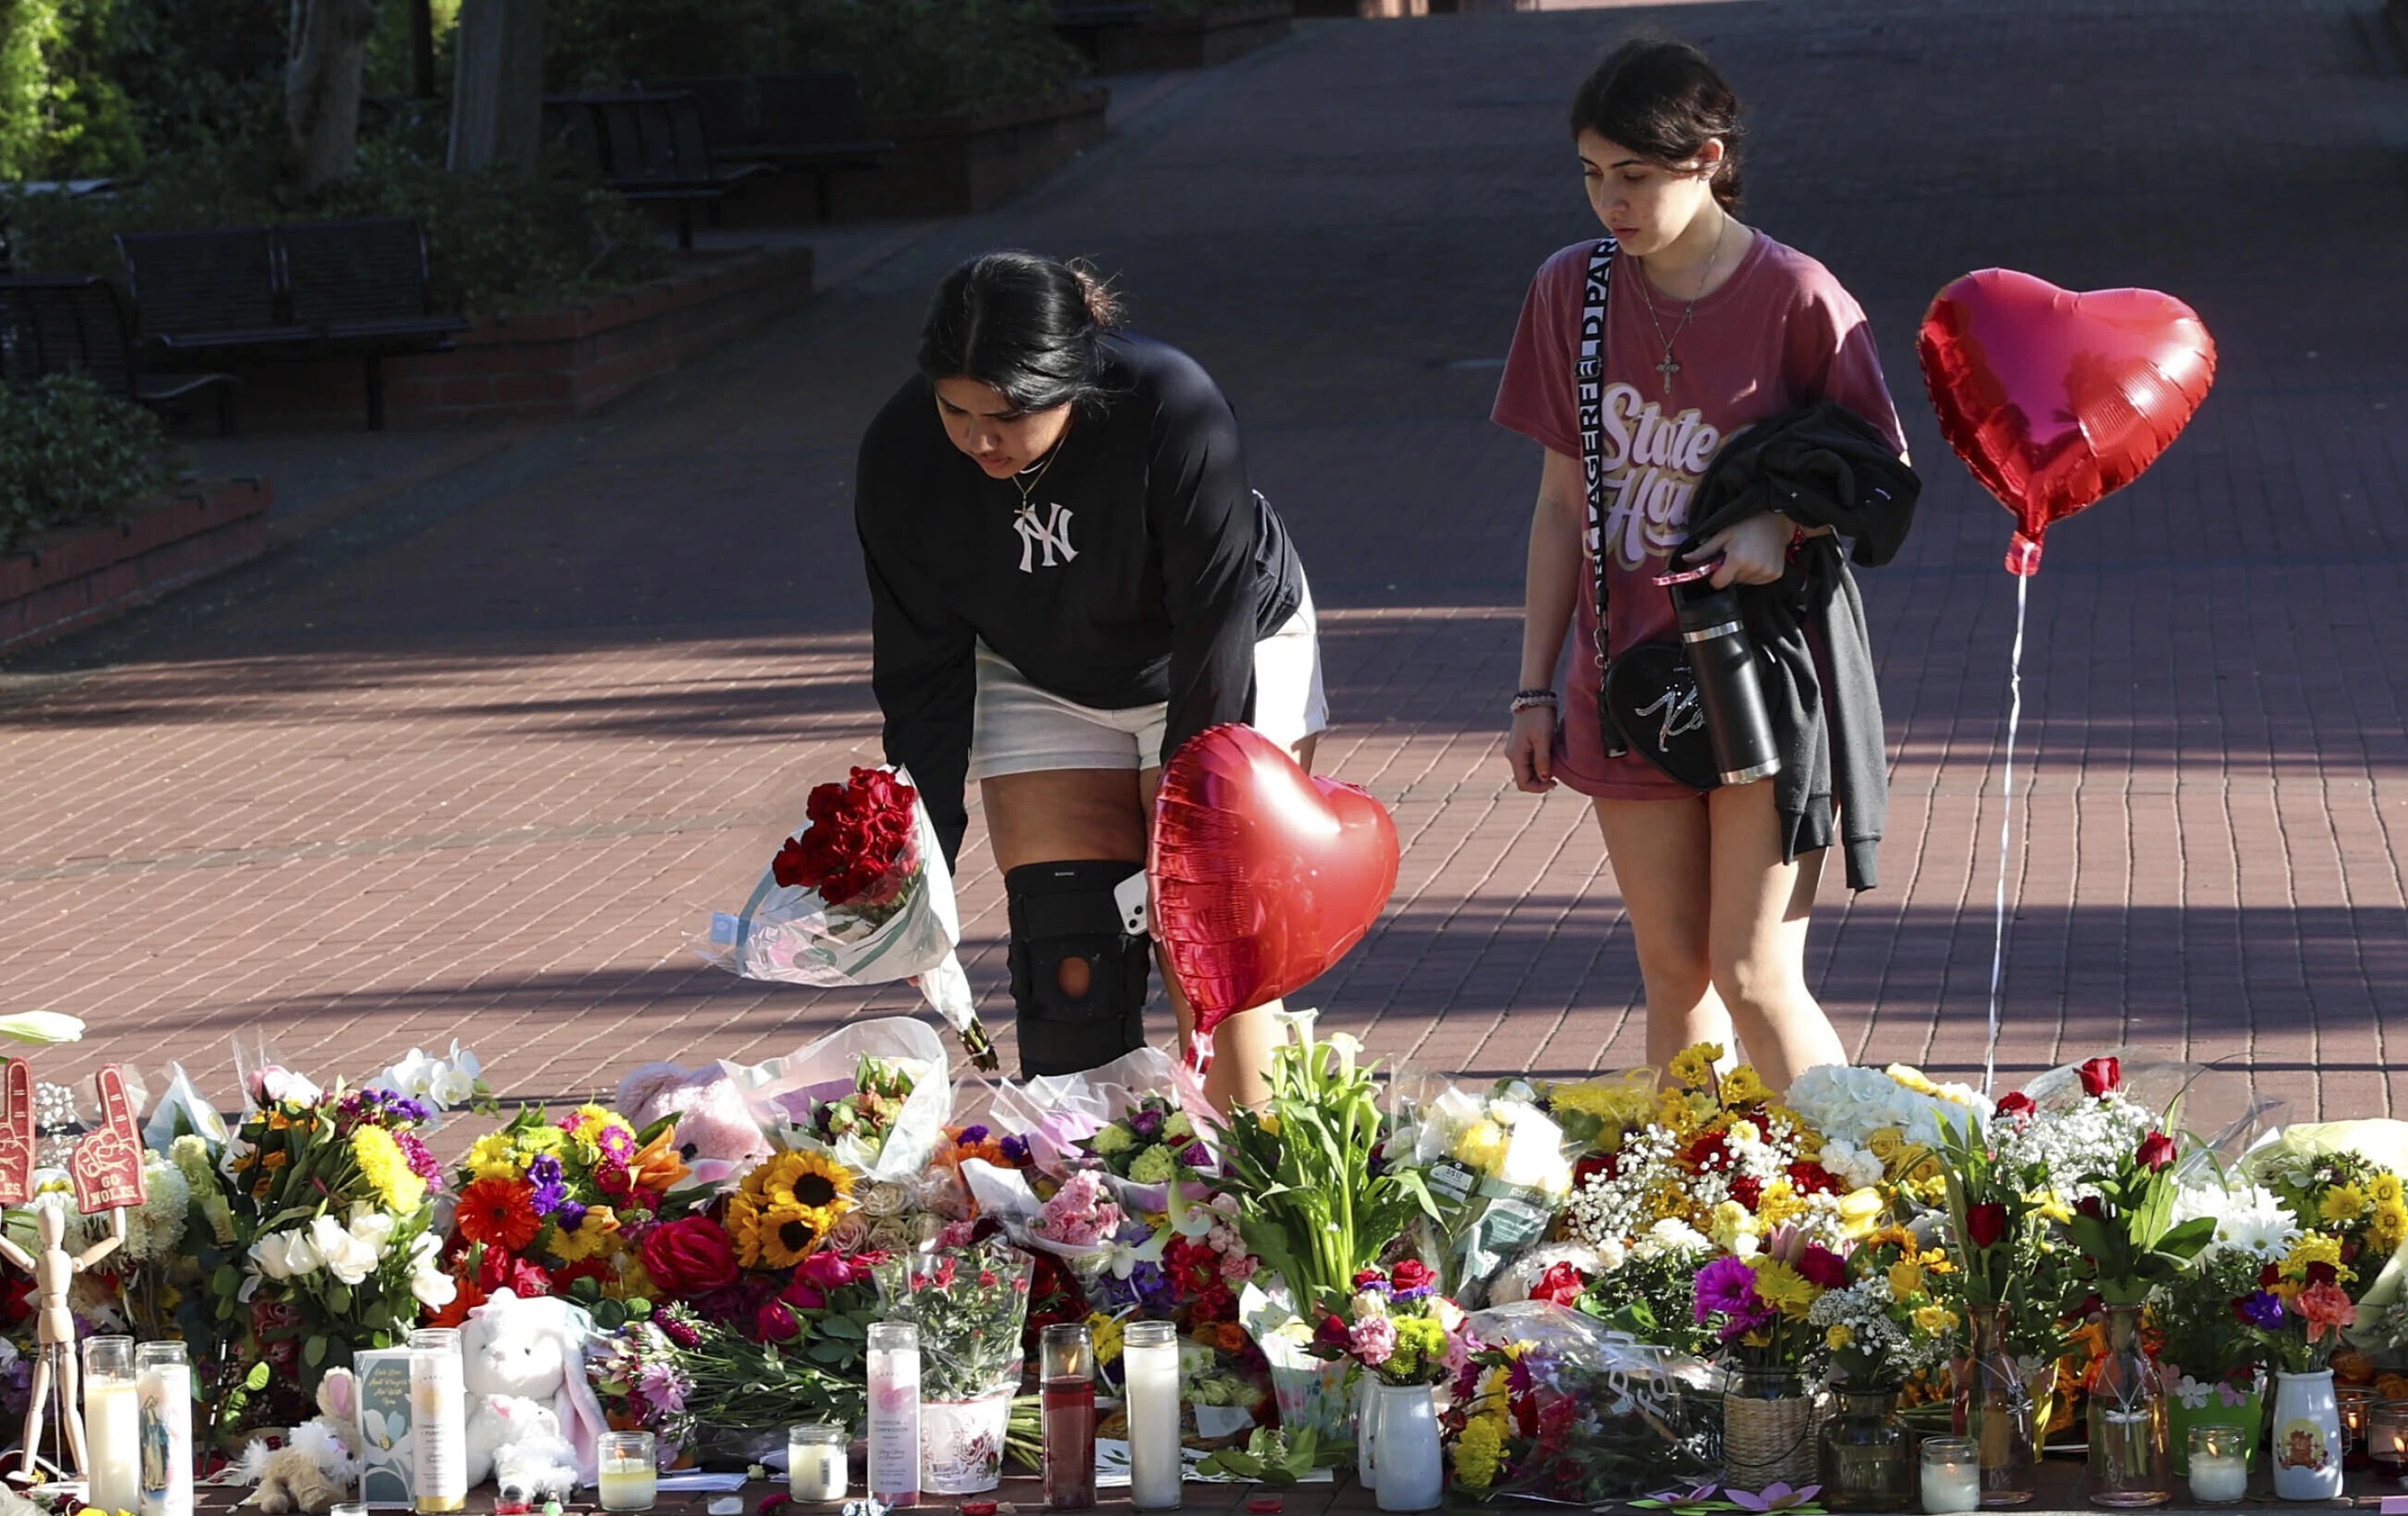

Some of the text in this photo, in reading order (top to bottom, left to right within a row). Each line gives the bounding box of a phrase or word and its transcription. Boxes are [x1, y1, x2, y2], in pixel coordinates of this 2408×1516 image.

[1577, 316, 1603, 527] LAGERFELD
[1601, 385, 1720, 473] State
[1013, 502, 1080, 574] NY
[101, 1174, 121, 1188] GO
